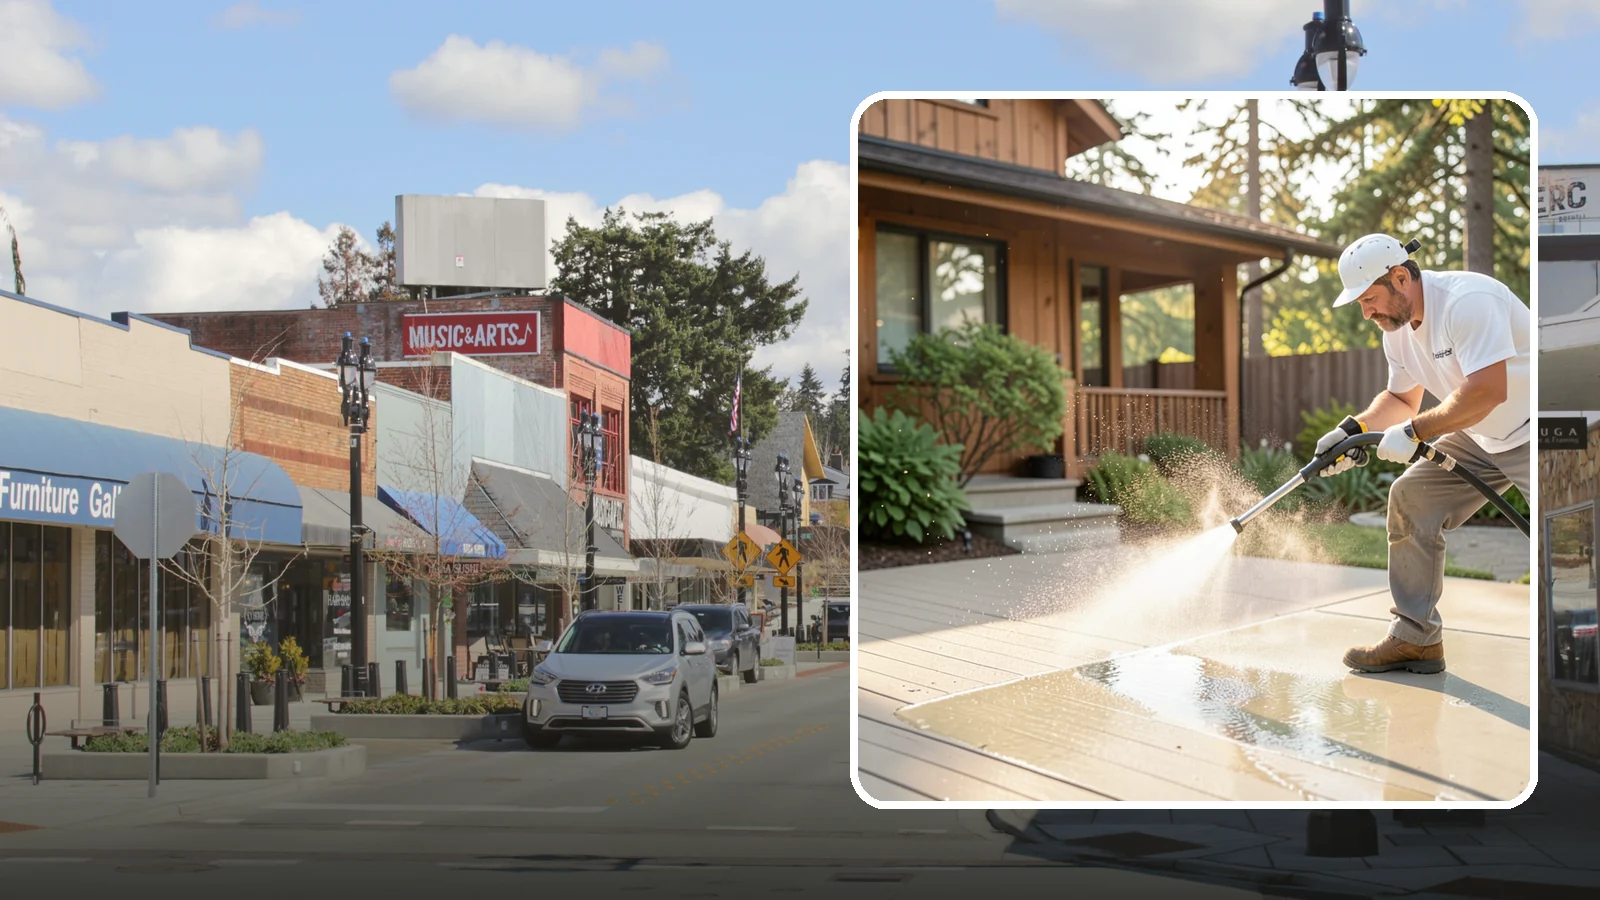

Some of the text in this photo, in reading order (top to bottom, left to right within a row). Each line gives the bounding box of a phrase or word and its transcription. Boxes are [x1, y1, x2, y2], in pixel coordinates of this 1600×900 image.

[409, 323, 520, 349] MUSIC&ARTS
[0, 471, 122, 519] Furniture Gal
